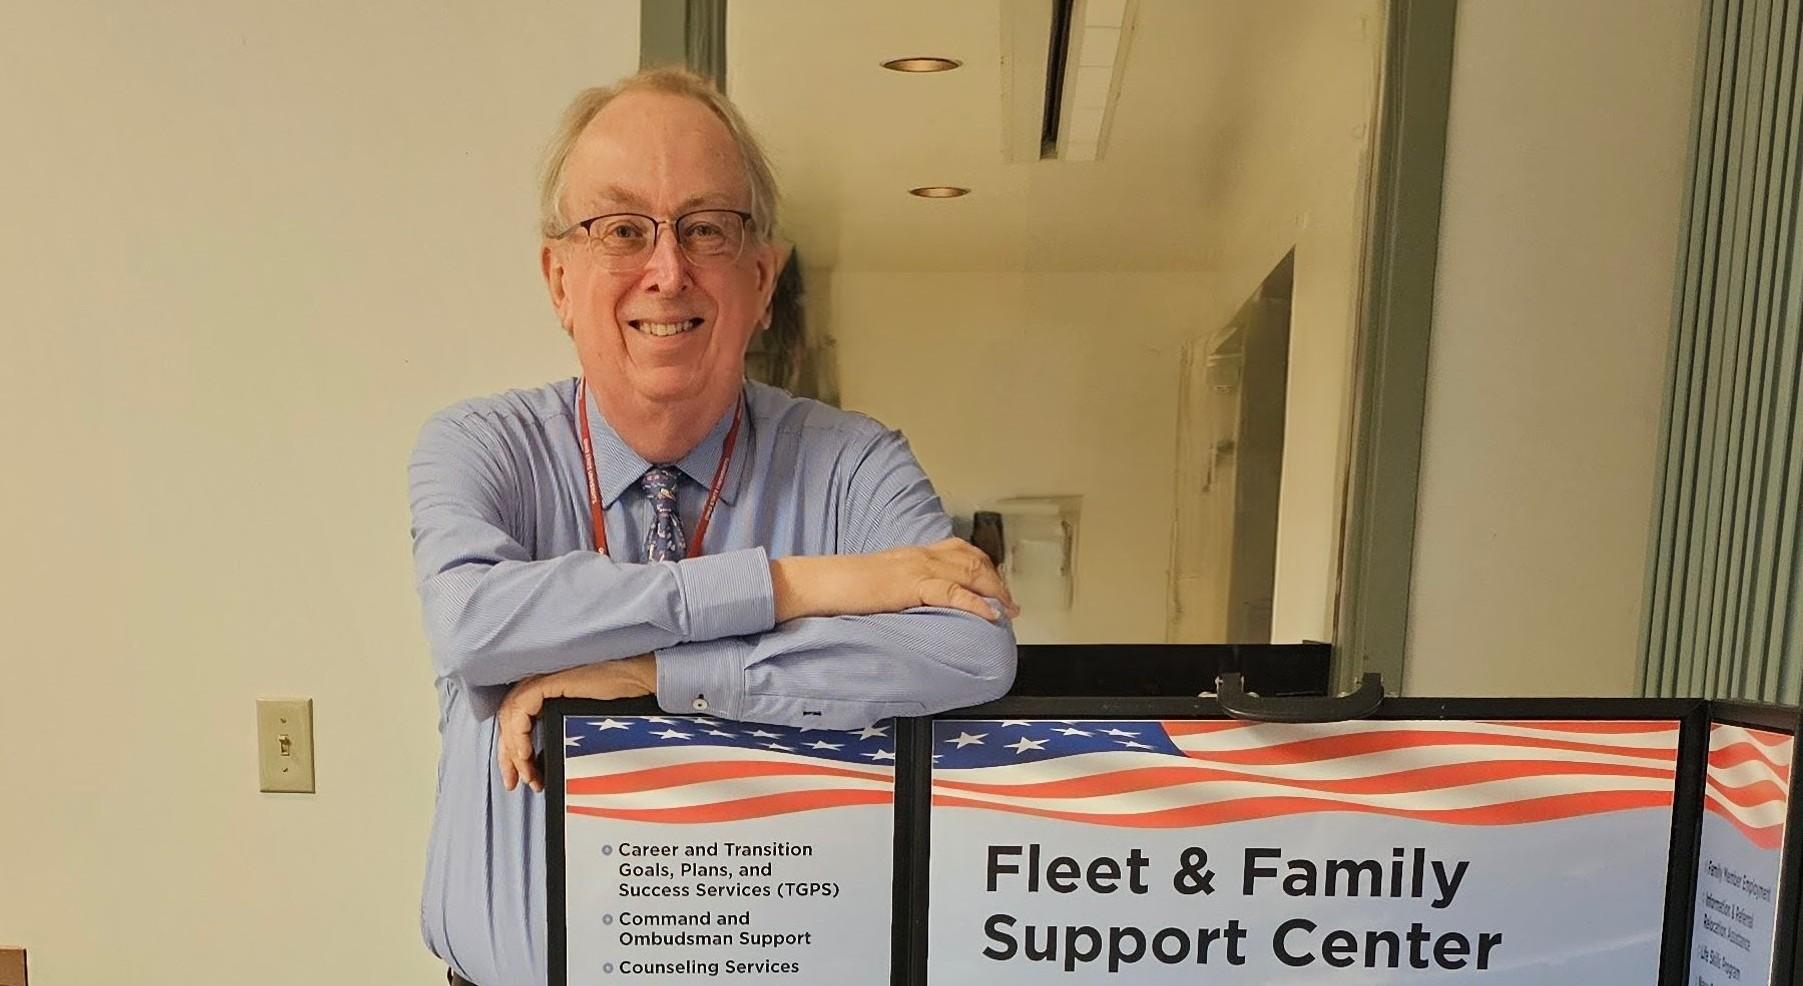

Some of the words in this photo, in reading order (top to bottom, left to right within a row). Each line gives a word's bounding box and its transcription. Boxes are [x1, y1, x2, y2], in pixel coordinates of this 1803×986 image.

[618, 842, 679, 857] Career
[684, 841, 718, 857] and
[723, 841, 813, 857] Transition
[619, 862, 674, 880] Goals,
[681, 862, 733, 880] Plans,
[738, 861, 772, 877] and
[986, 843, 1150, 895] Fleet
[1173, 846, 1216, 896] &
[1242, 847, 1471, 910] Family
[618, 882, 690, 897] Success
[695, 882, 771, 897] Services
[777, 882, 840, 899] (TGPS)
[619, 911, 711, 926] Command
[716, 910, 750, 926] and
[619, 931, 733, 946] Ombudsman
[739, 931, 812, 948] Support
[982, 913, 1248, 974] Support
[1272, 918, 1503, 971] Center
[619, 959, 719, 977] Counseling
[725, 958, 800, 974] Services
